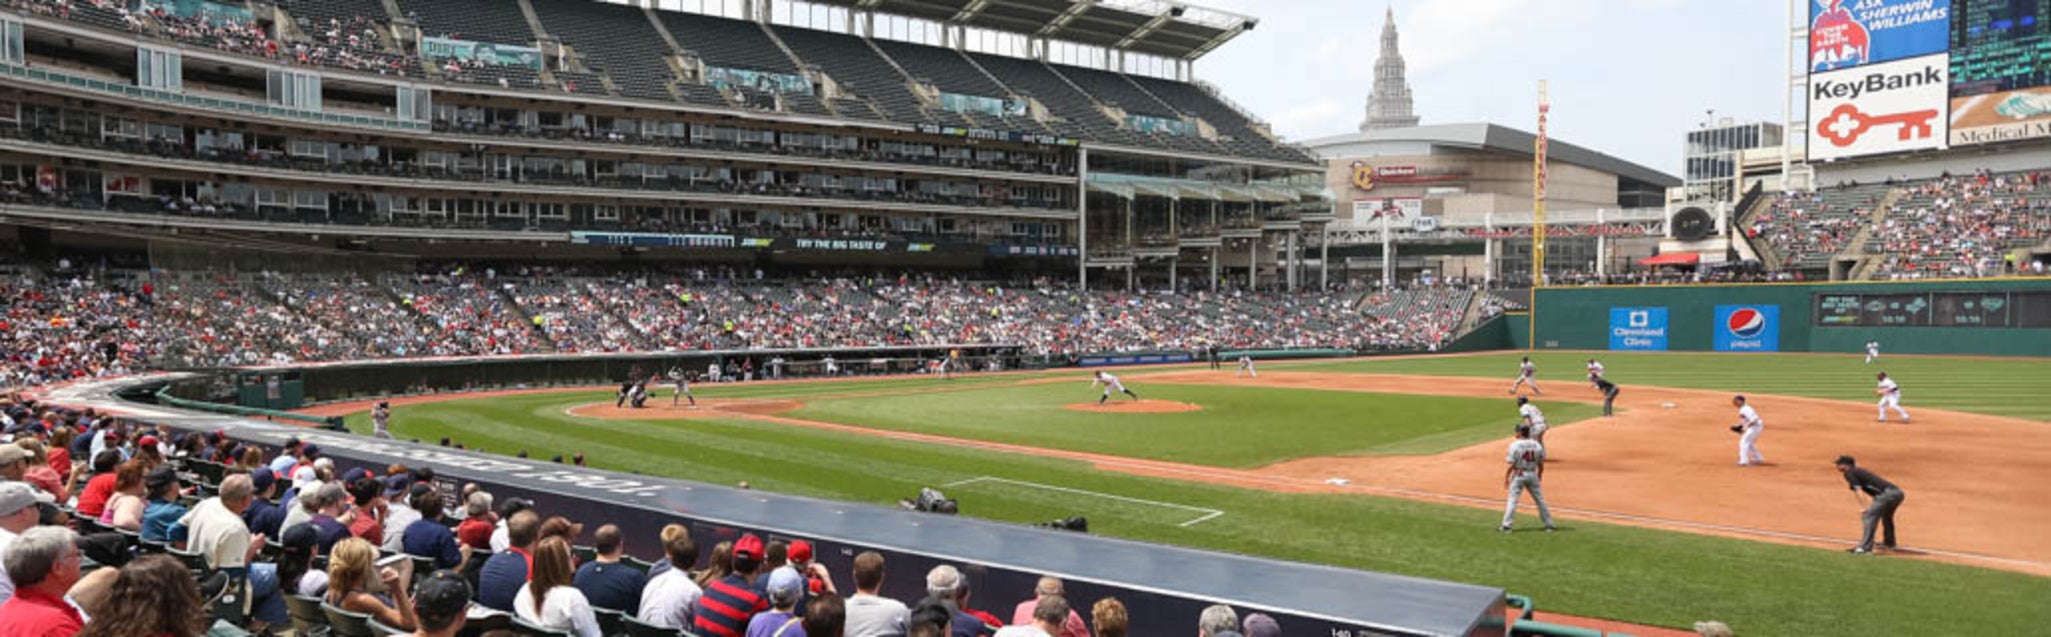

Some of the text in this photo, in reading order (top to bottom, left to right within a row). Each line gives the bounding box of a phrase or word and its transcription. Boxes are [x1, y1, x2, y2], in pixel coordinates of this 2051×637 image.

[1853, 0, 1885, 11] ASK
[1860, 0, 1933, 20] SHERWIN
[1869, 7, 1947, 31] WILLIAMS
[1814, 65, 1942, 100] KeyBank
[1961, 124, 2029, 142] Medical
[797, 239, 887, 250] TRY THE BIG TASTE OF
[1614, 327, 1664, 337] Cleveland
[1624, 337, 1652, 347] Clinic
[1730, 340, 1761, 349] pepsi
